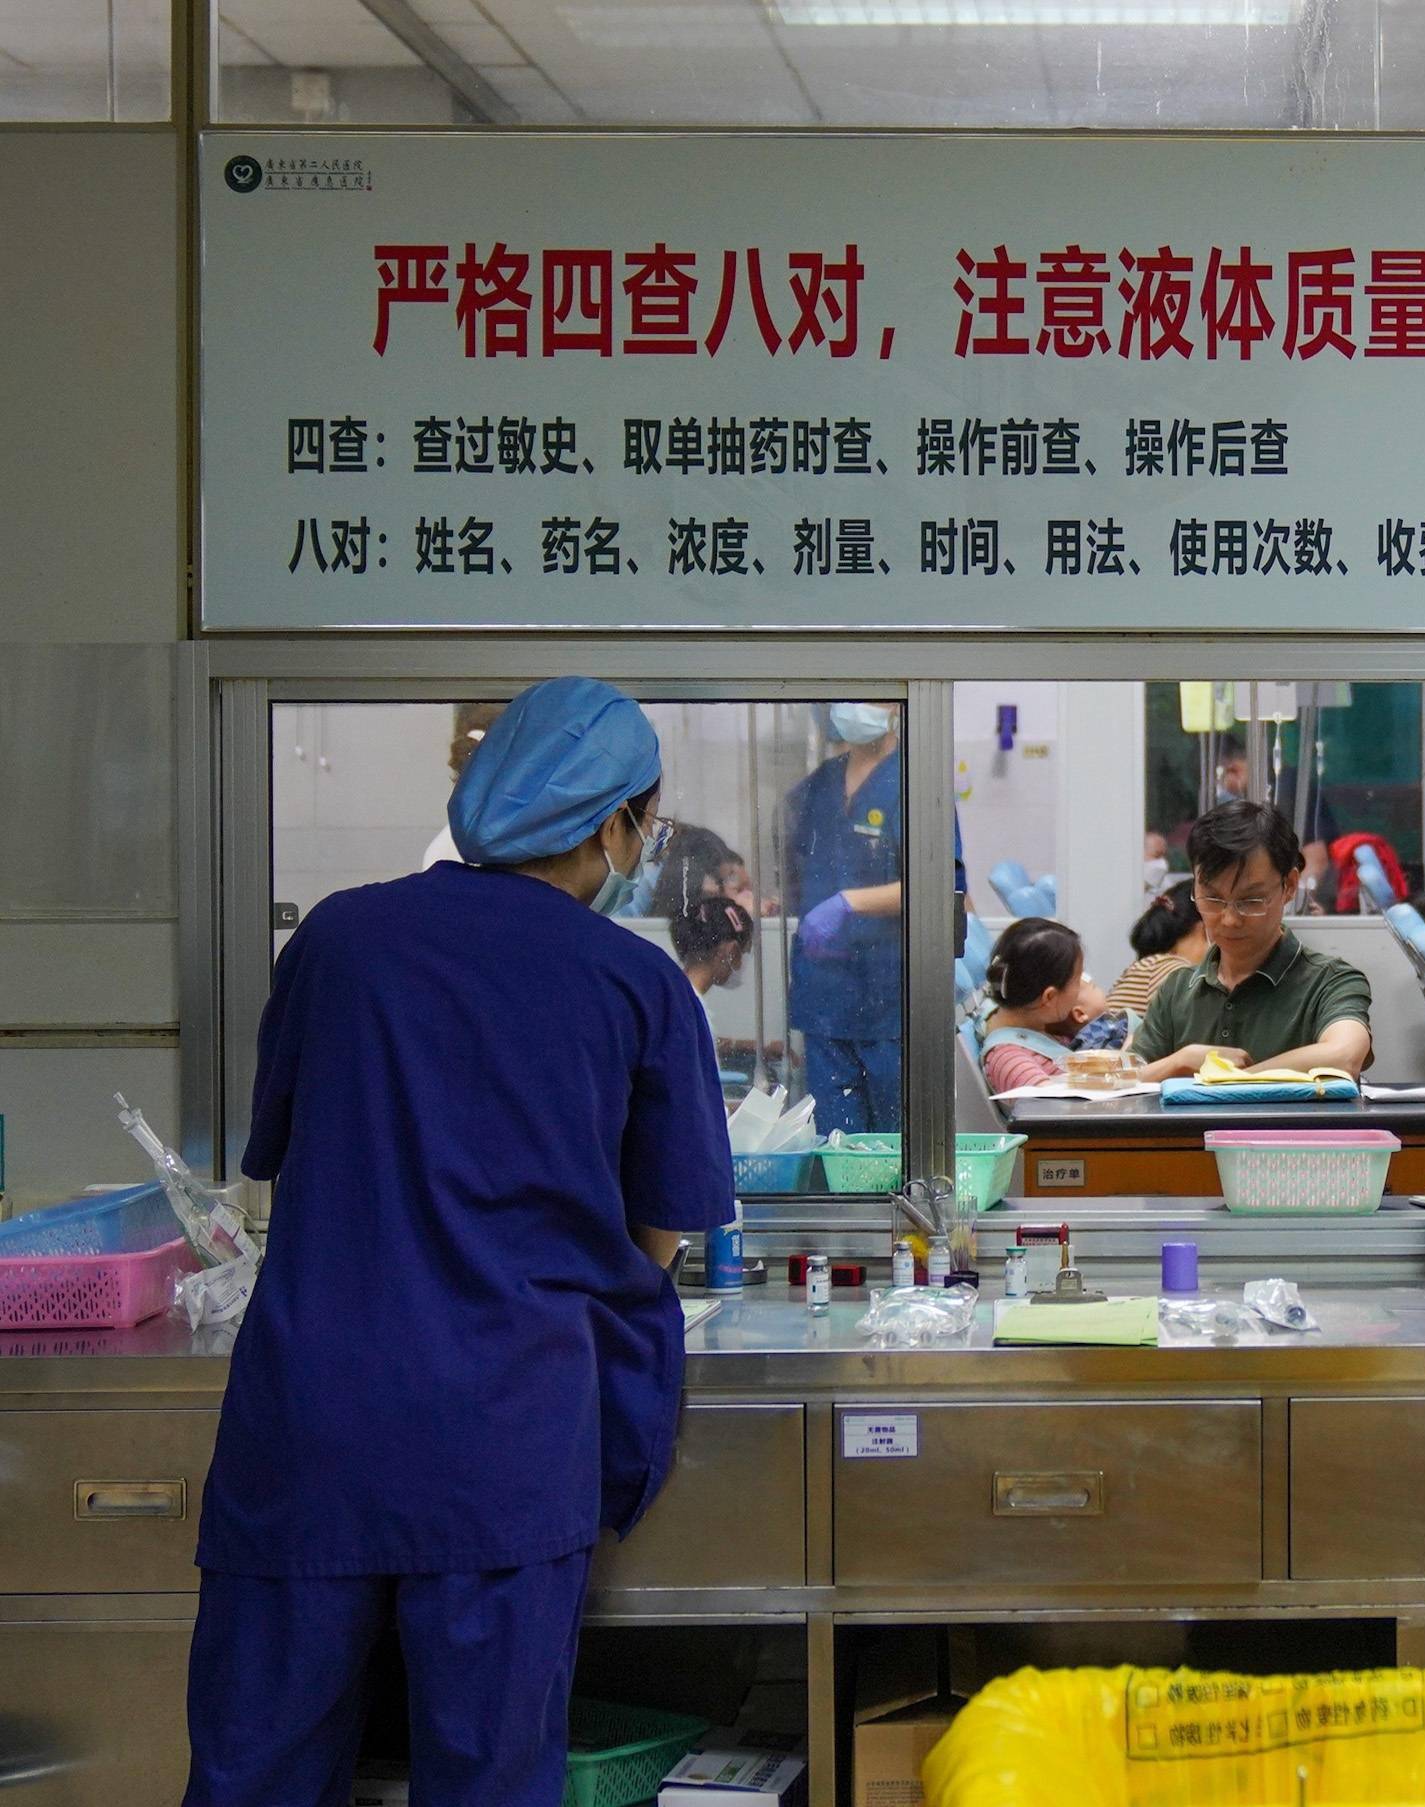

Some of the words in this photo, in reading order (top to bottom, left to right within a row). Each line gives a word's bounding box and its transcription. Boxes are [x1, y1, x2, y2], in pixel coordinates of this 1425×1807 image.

[287, 414, 1289, 478] 四查：查过敏史、取单抽药时查、操作前查、操作后查
[1042, 1168, 1080, 1180] 治疗单
